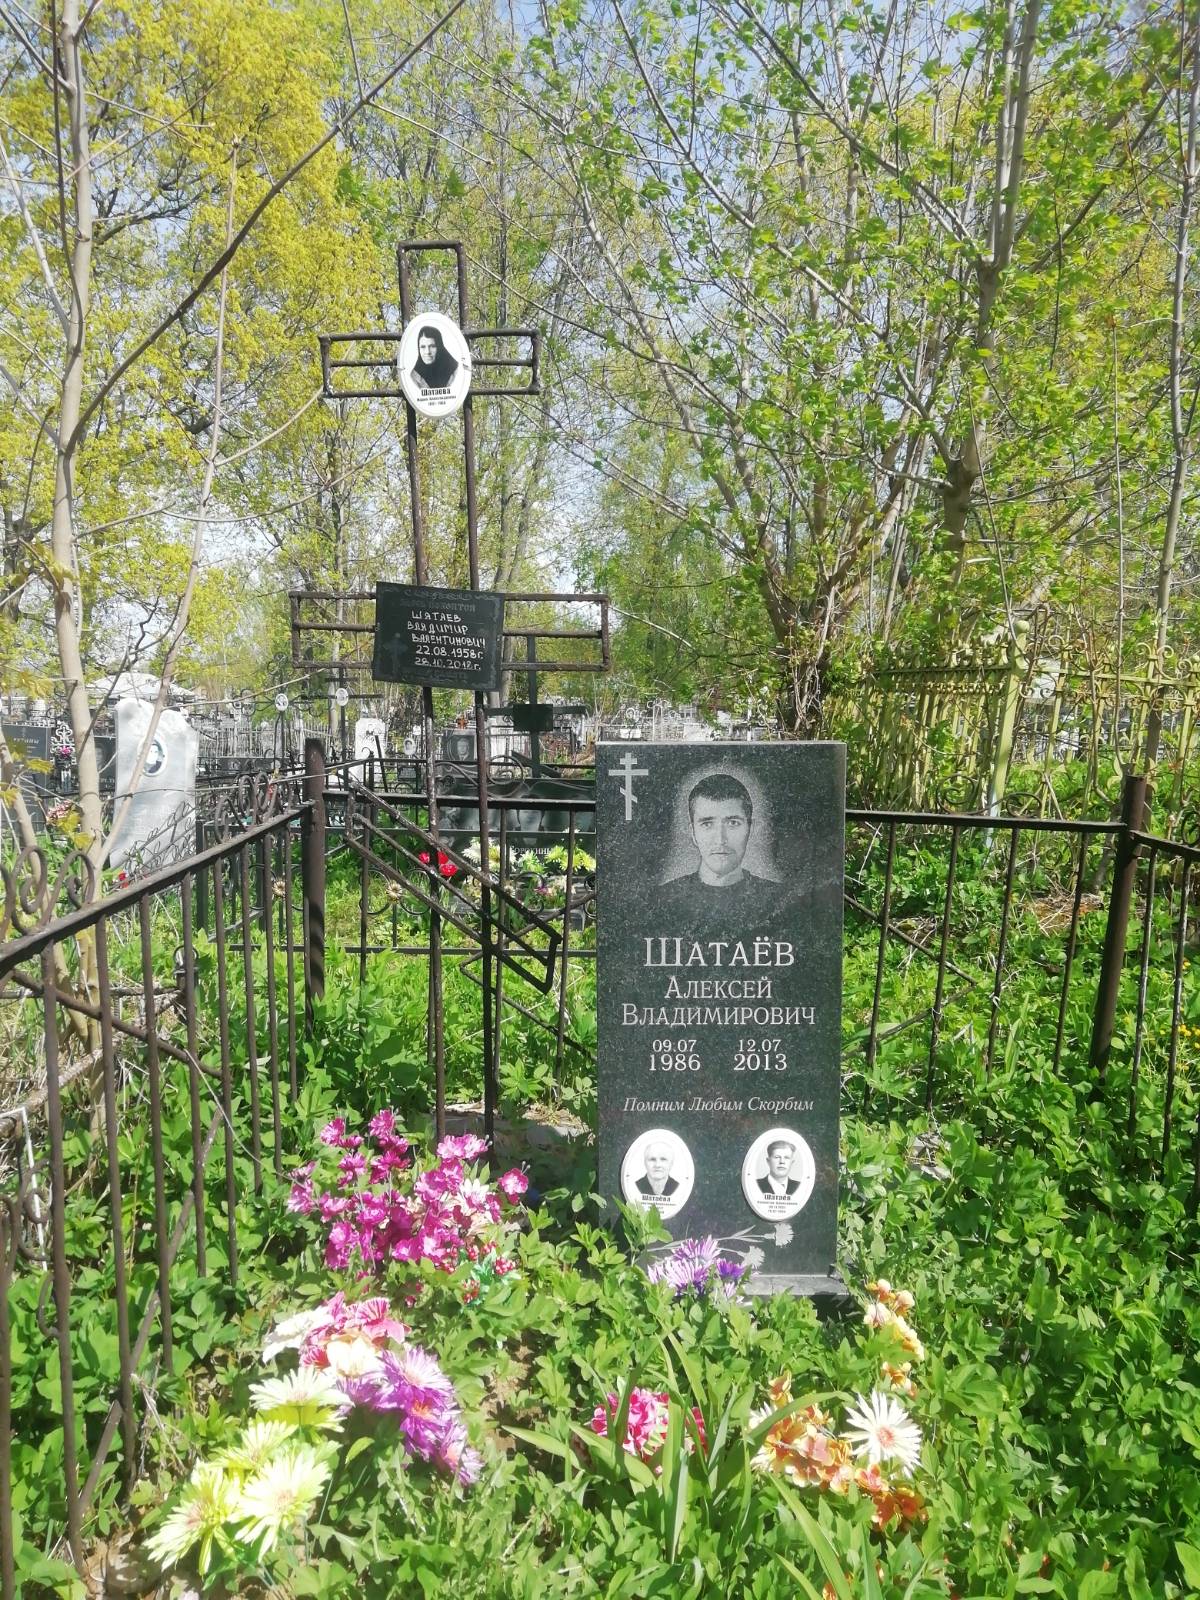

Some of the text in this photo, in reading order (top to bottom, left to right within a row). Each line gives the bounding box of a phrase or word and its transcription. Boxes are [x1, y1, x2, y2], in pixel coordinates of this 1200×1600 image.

[411, 610, 462, 622] ШАТАЕВ
[407, 621, 469, 635] ВЛАДИМИР
[411, 633, 486, 648] ВАЛЕНТИНОВИЧ
[643, 936, 795, 967] ШАТАЁВ
[664, 975, 773, 999] АЛЕКСЕЙ
[621, 1003, 816, 1028] ВЛАДИМИРОВИЧ
[652, 1039, 697, 1053] 09.07
[738, 1039, 782, 1052] 12.07
[649, 1053, 701, 1071] 1986
[733, 1053, 788, 1071] 2013
[623, 1097, 814, 1114] Помним Любим Скорбим
